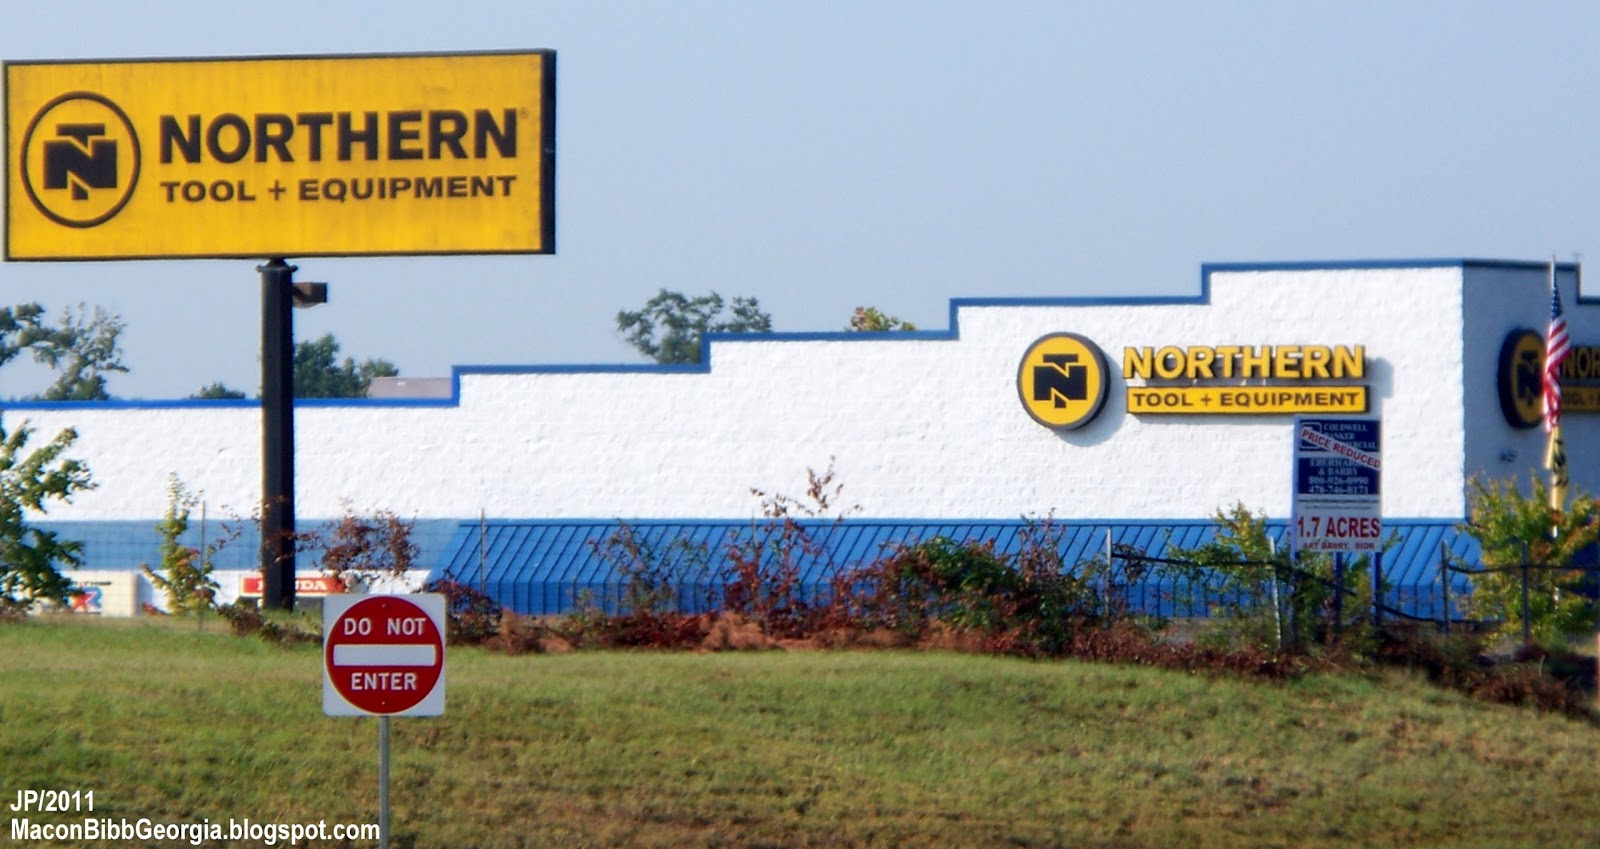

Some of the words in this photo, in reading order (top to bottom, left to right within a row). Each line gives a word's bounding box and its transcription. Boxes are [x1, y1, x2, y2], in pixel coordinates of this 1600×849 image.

[159, 107, 517, 164] NORTHERN
[160, 180, 256, 202] TOOL
[298, 175, 517, 202] EQUIPMENT
[1123, 344, 1366, 379] NORTHERN
[1133, 393, 1193, 407] TOOL
[1219, 391, 1360, 408] EQUIPMENT
[1301, 429, 1332, 449] PRICE
[1332, 442, 1381, 469] REDUCED
[1297, 516, 1322, 537] 1.7
[1325, 516, 1381, 538] ACRES
[343, 617, 372, 636] DO
[386, 617, 426, 636] NOT
[351, 672, 418, 691] ENTER
